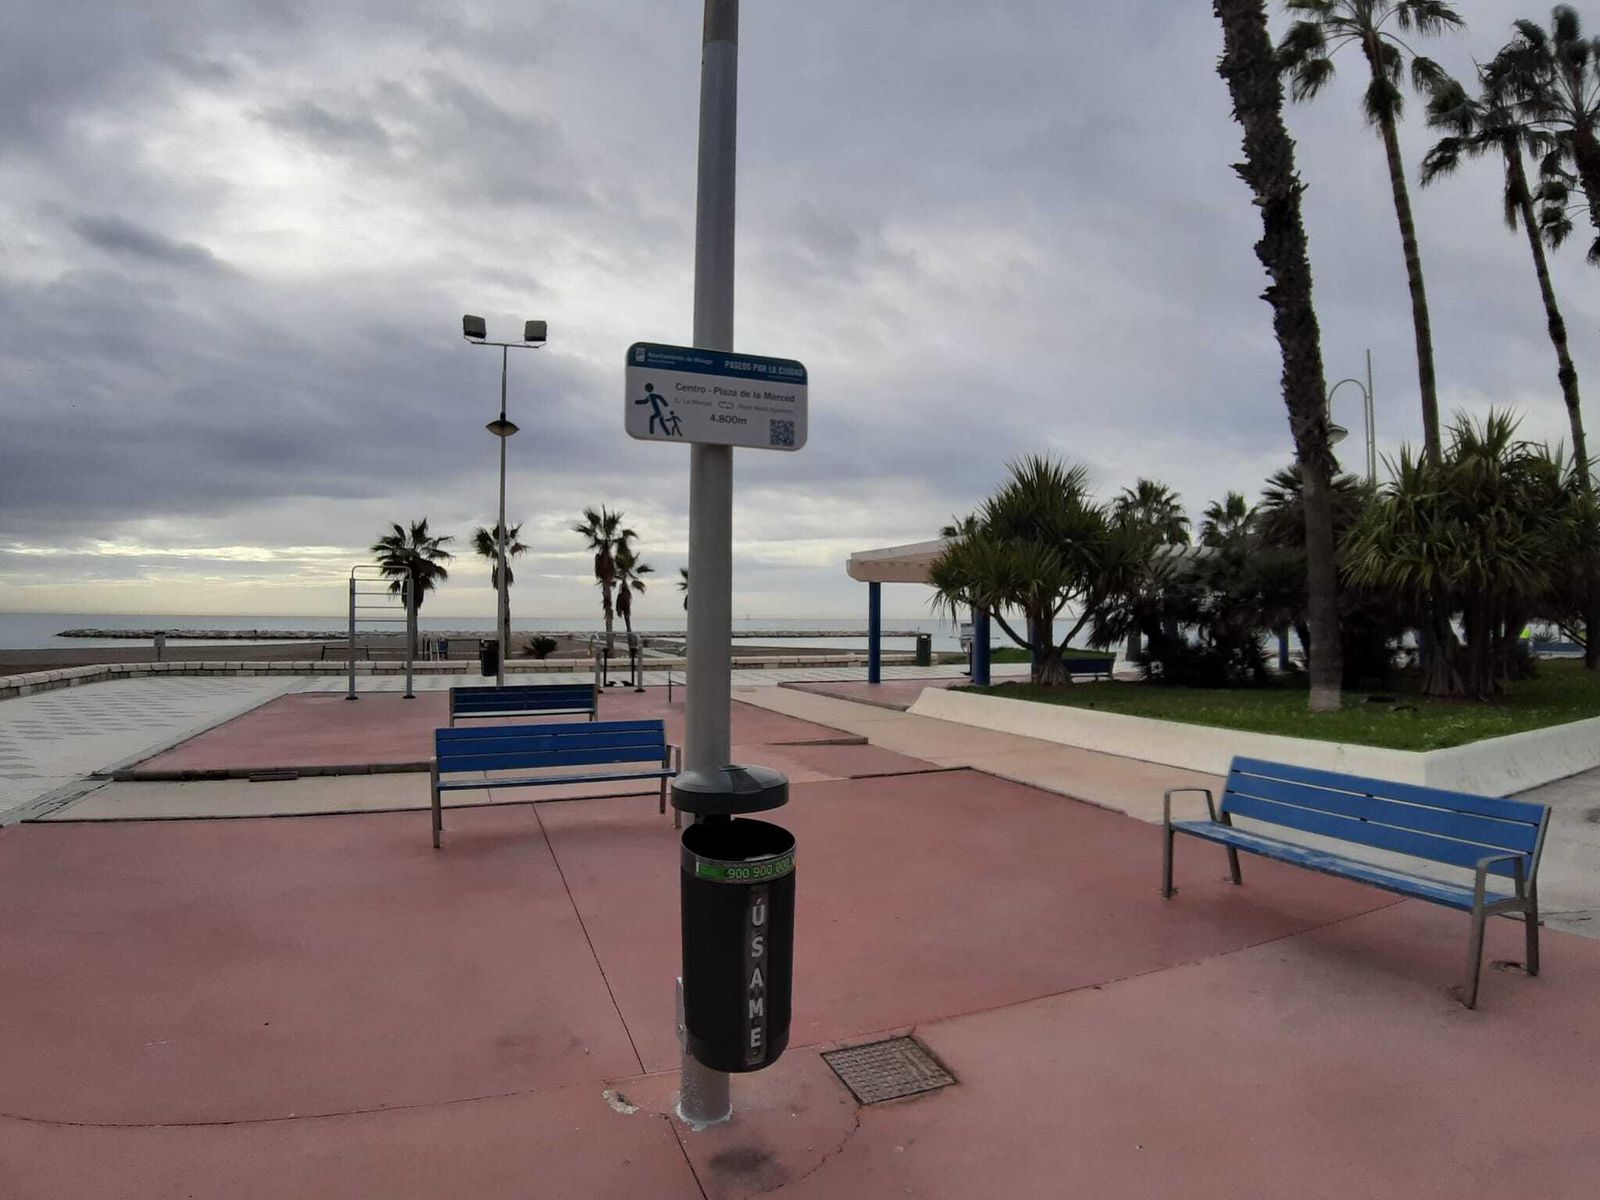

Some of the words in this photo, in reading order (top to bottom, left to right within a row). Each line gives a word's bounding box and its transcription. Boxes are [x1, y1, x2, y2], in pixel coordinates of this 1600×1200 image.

[752, 364, 767, 373] POR
[768, 366, 776, 374] LA
[778, 367, 803, 377] CIUDAD
[675, 383, 706, 394] Centro
[713, 386, 737, 397] Plaza
[740, 390, 751, 398] de
[753, 391, 762, 399] la
[764, 392, 795, 403] Merced
[710, 414, 747, 425] 4.800m
[727, 868, 750, 878] 900
[753, 864, 773, 877] 900
[748, 898, 765, 1047] ÚSAME
